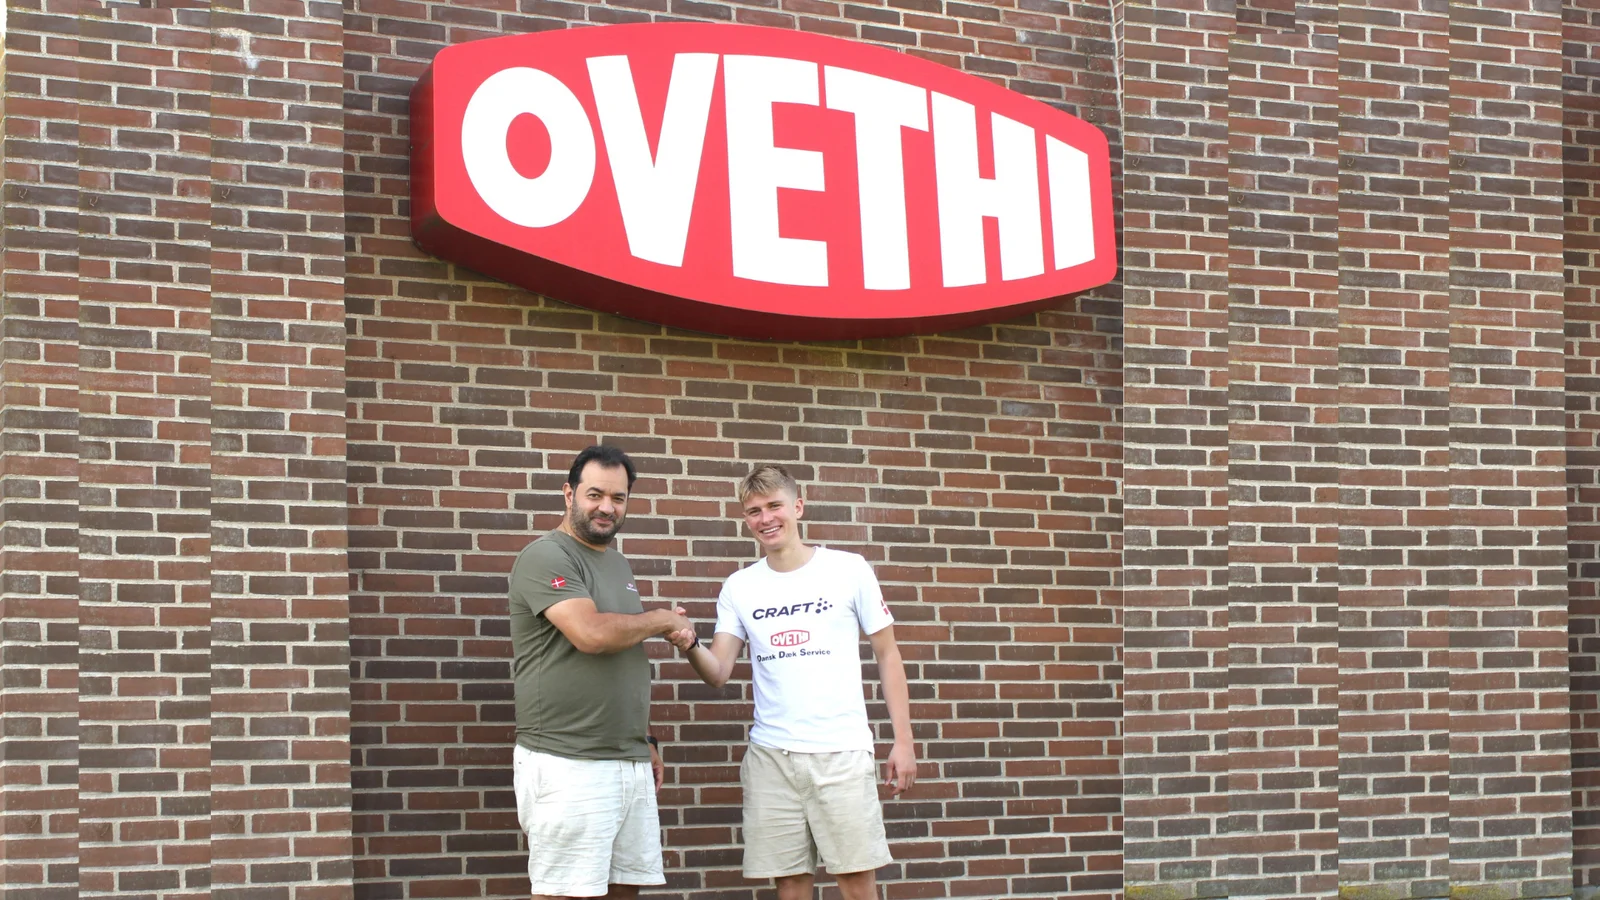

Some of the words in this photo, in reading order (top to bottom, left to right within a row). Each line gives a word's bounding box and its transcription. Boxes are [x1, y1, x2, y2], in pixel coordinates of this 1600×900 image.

[461, 53, 1096, 290] OVETHI
[752, 602, 814, 620] CRAFT
[772, 631, 809, 646] OVETHI
[756, 654, 777, 663] Dansk
[778, 651, 798, 659] Dæk
[799, 648, 831, 657] Service
